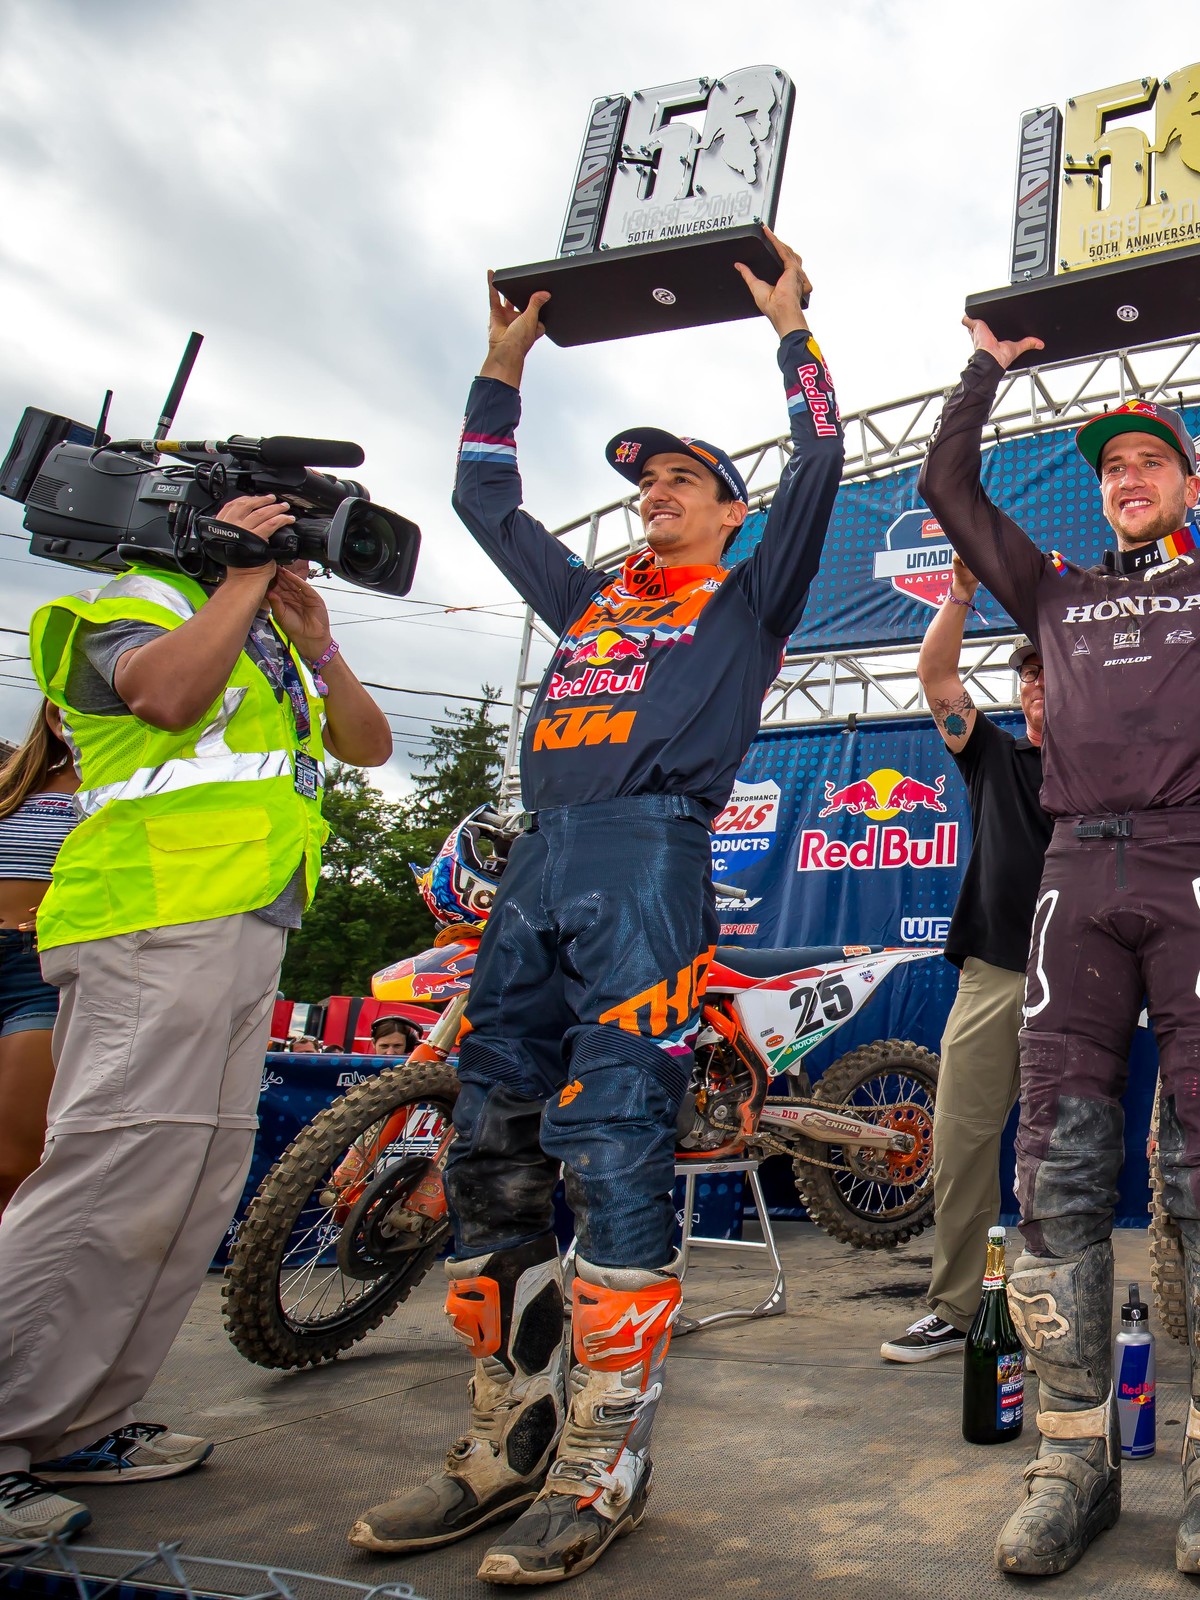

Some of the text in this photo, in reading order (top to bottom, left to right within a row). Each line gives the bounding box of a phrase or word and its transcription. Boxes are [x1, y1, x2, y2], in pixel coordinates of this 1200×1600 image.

[562, 96, 622, 252] UNADILLA
[1013, 108, 1054, 273] UNADILLA
[627, 215, 735, 244] 50TH ANNIVERSARY
[1088, 241, 1119, 258] 50TH
[797, 363, 827, 400] Red
[809, 400, 838, 437] Bull
[1135, 551, 1159, 567] FOX
[1102, 656, 1152, 667] DUNLOP
[547, 662, 650, 700] Red Bull
[532, 705, 637, 752] KTM
[730, 795, 778, 803] ERFORMANCE
[797, 823, 959, 872] Red Bull
[789, 974, 854, 1039] 25
[791, 1032, 824, 1052] MOTOREX
[781, 1110, 799, 1121] DID
[1121, 1383, 1141, 1395] Red
